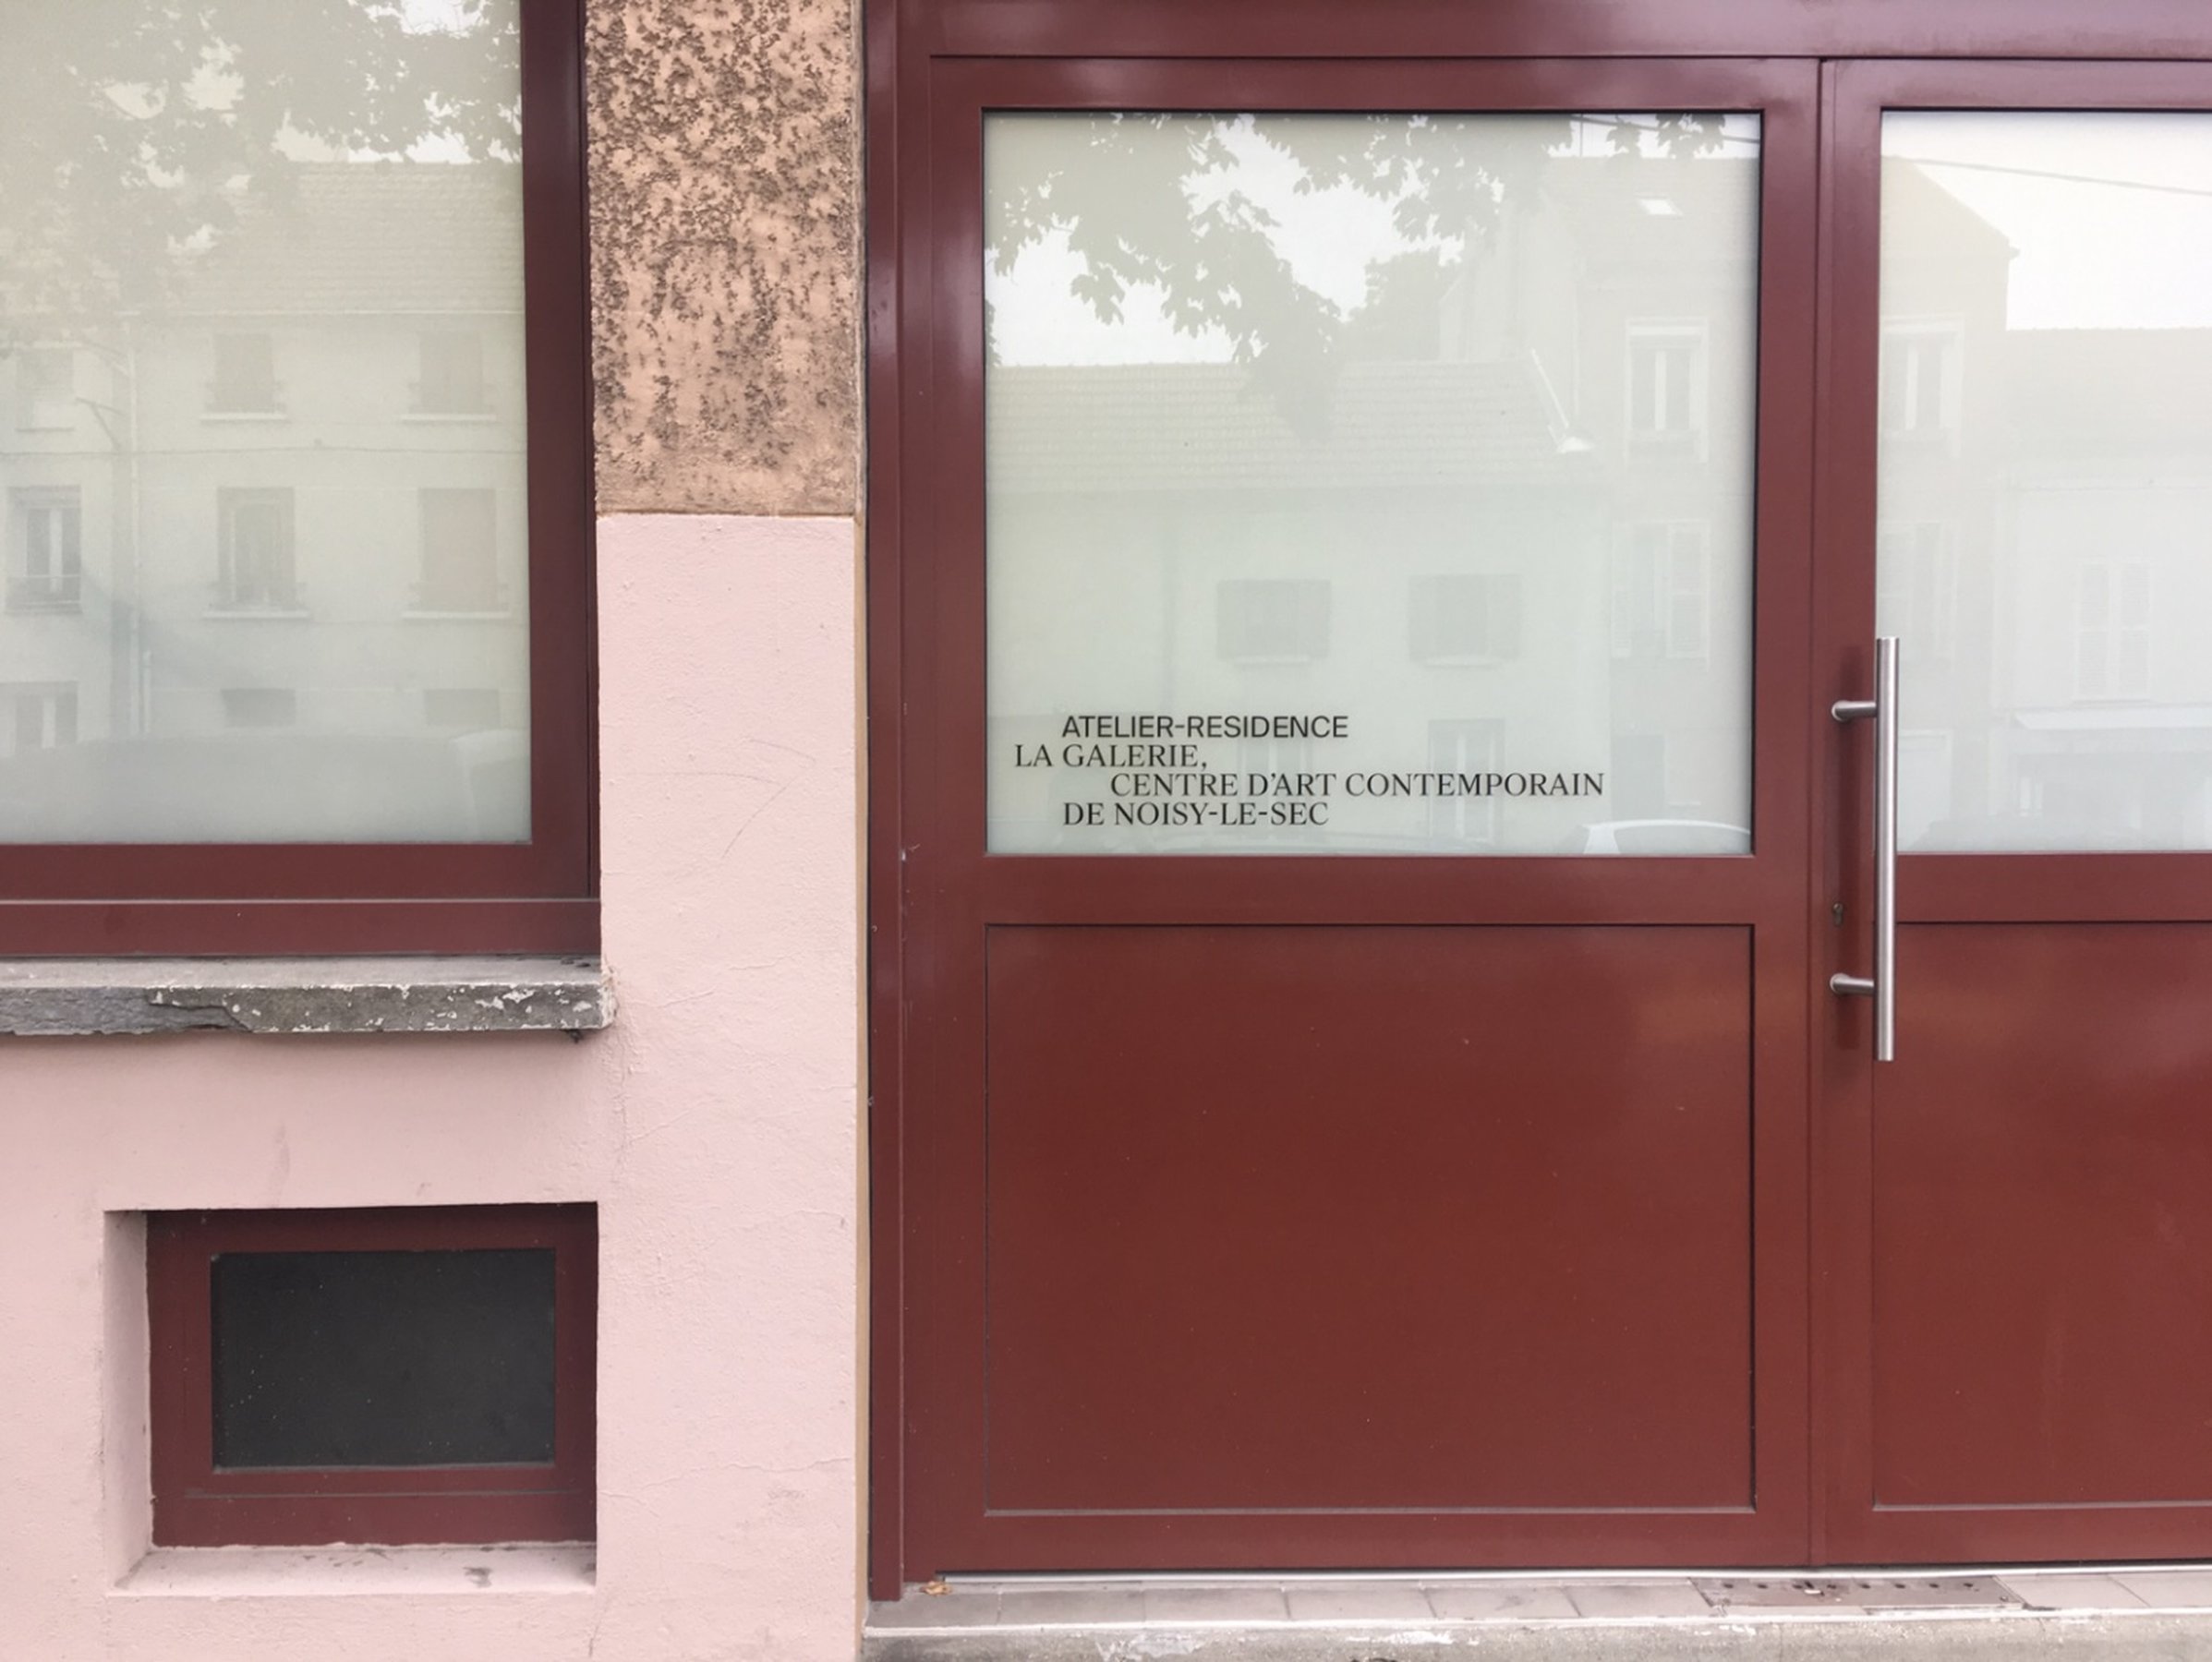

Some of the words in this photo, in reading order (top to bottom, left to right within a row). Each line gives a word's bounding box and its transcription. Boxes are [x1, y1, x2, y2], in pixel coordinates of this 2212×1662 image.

[1061, 715, 1348, 739] ATELIER-RESIDENCE
[1015, 743, 1054, 767] LA
[1062, 743, 1207, 771] GALERIE,
[1110, 772, 1239, 798] CENTRE
[1248, 772, 1337, 797] D'ART
[1345, 773, 1604, 797] CONTEMPORAIN
[1063, 801, 1105, 826] DE
[1114, 801, 1328, 826] NOISY-LE-SEC
